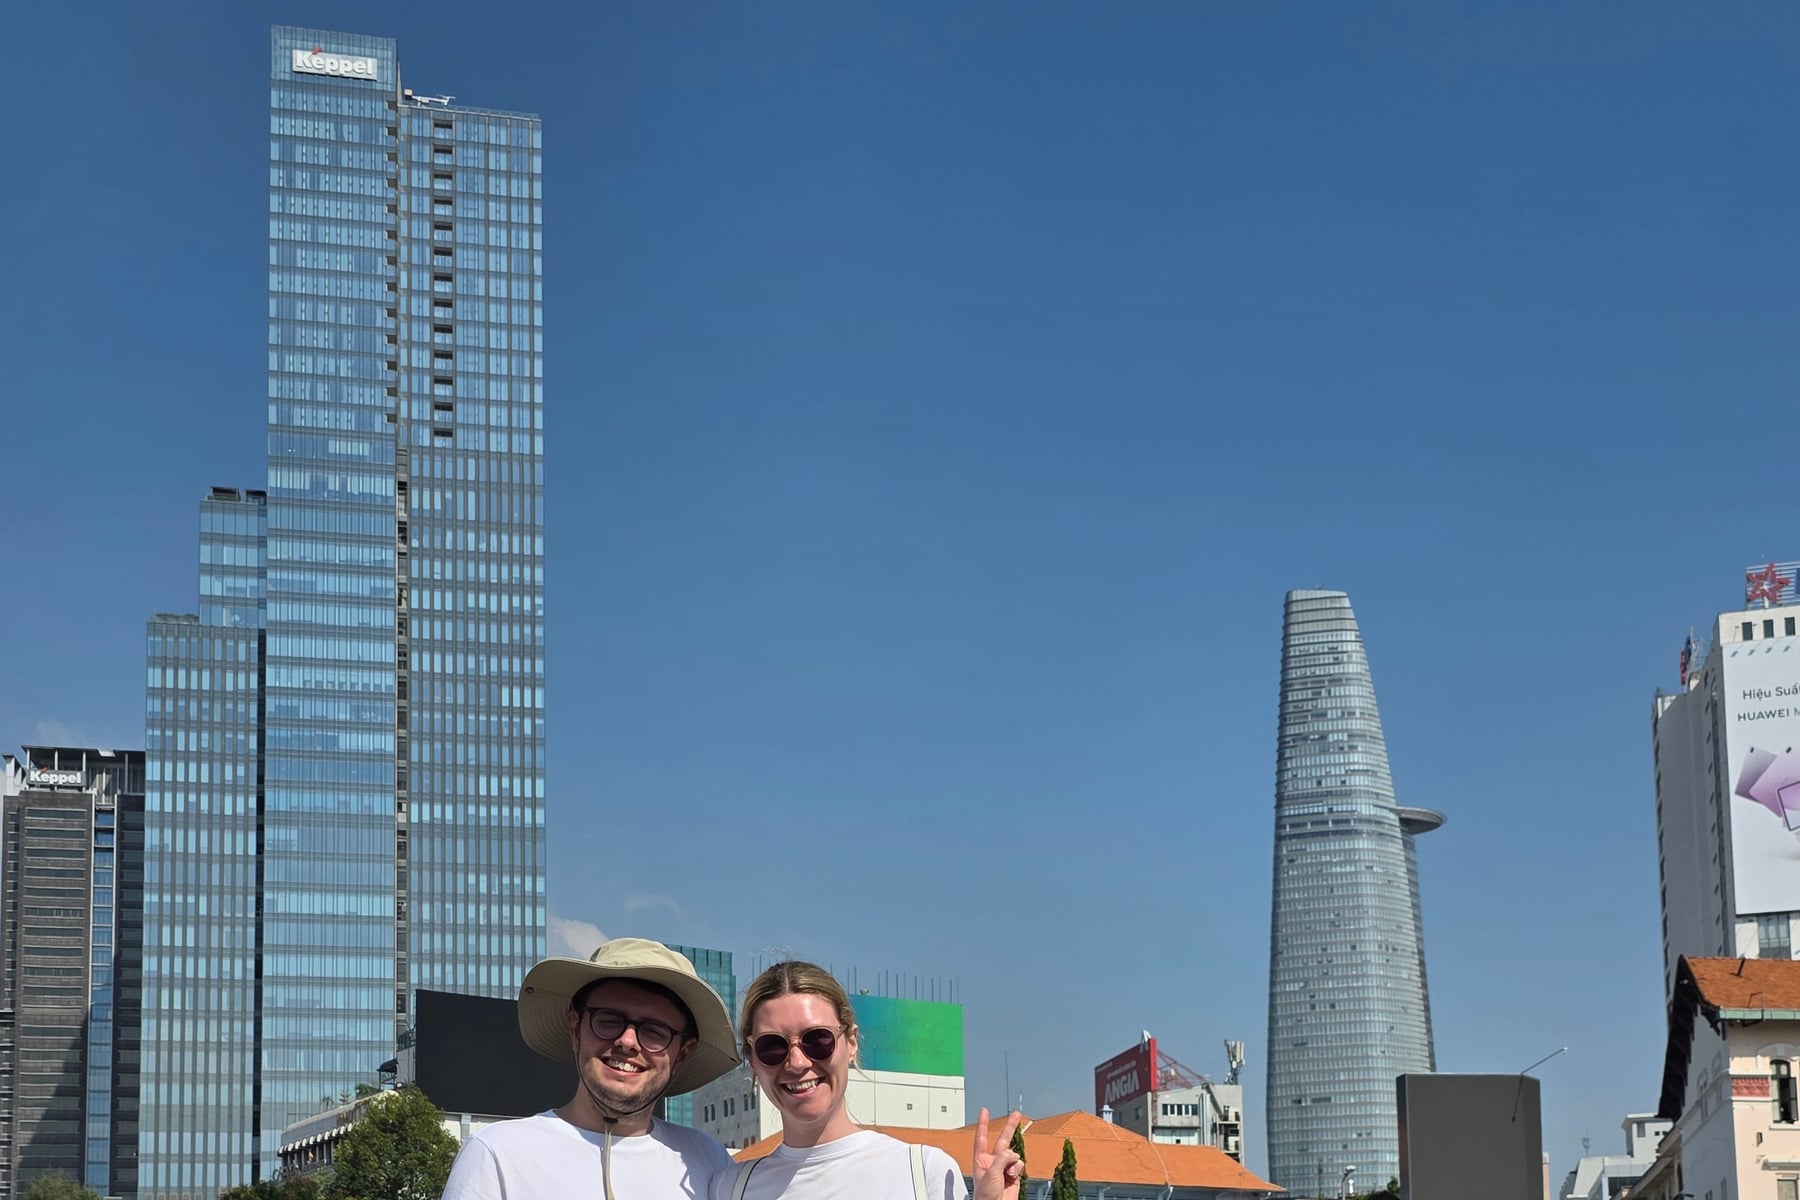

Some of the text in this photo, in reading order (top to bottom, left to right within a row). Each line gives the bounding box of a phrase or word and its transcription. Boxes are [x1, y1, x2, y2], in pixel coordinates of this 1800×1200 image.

[295, 50, 374, 76] Keppel
[1743, 689, 1771, 701] Hiệu
[1737, 708, 1790, 722] HUAWEI
[30, 769, 82, 785] Keppel
